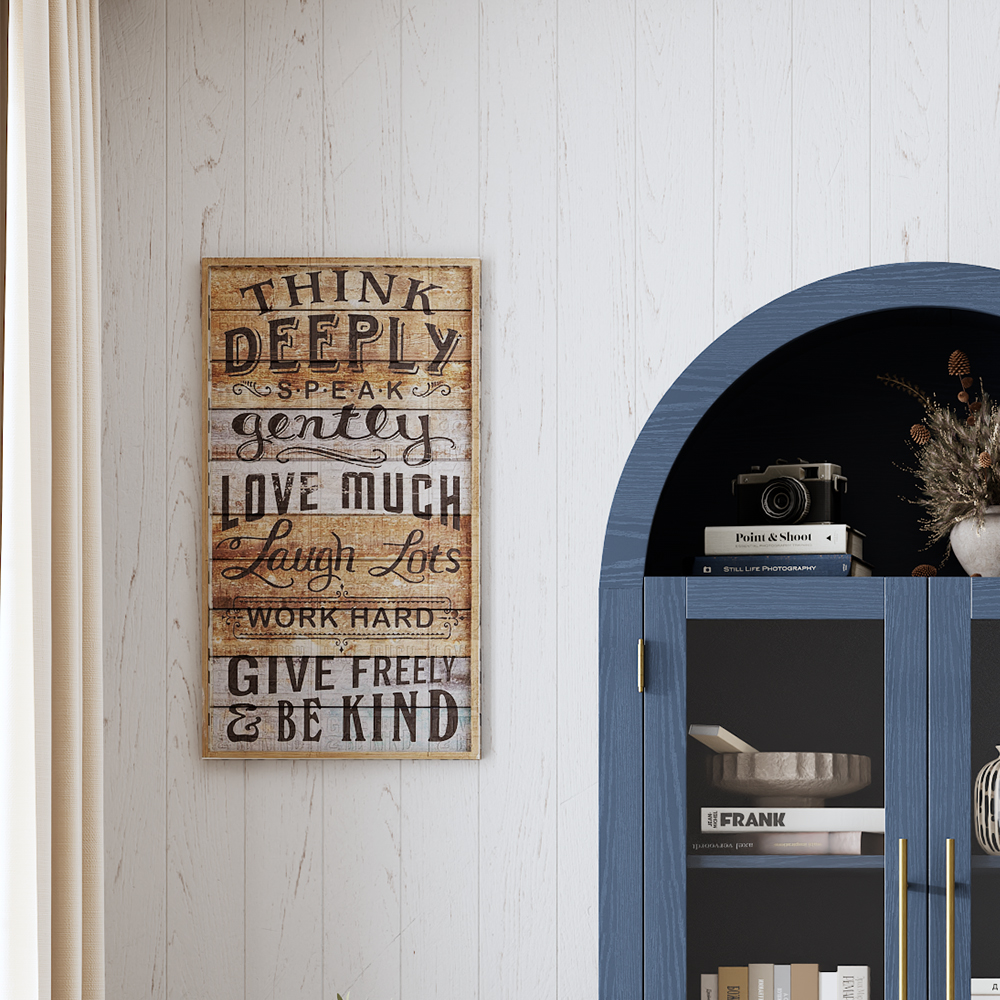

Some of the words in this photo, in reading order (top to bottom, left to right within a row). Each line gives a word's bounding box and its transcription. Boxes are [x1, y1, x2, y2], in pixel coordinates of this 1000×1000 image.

[240, 270, 442, 315] THINK
[224, 314, 461, 376] DEEPLY
[232, 404, 456, 467] gently
[222, 472, 319, 531] LOVE
[341, 471, 461, 531] MUCH
[216, 519, 355, 592] Laugh
[368, 529, 461, 583] Lots
[735, 532, 765, 542] Point
[768, 532, 777, 542] &
[779, 531, 812, 542] Shoot
[247, 607, 338, 628] WORK
[350, 607, 434, 628] HARD
[227, 655, 335, 697] GIVE
[352, 655, 456, 689] FREELY
[226, 703, 262, 742] &
[277, 697, 322, 743] BE
[342, 689, 459, 743] KIND
[720, 812, 786, 827] FRANK
